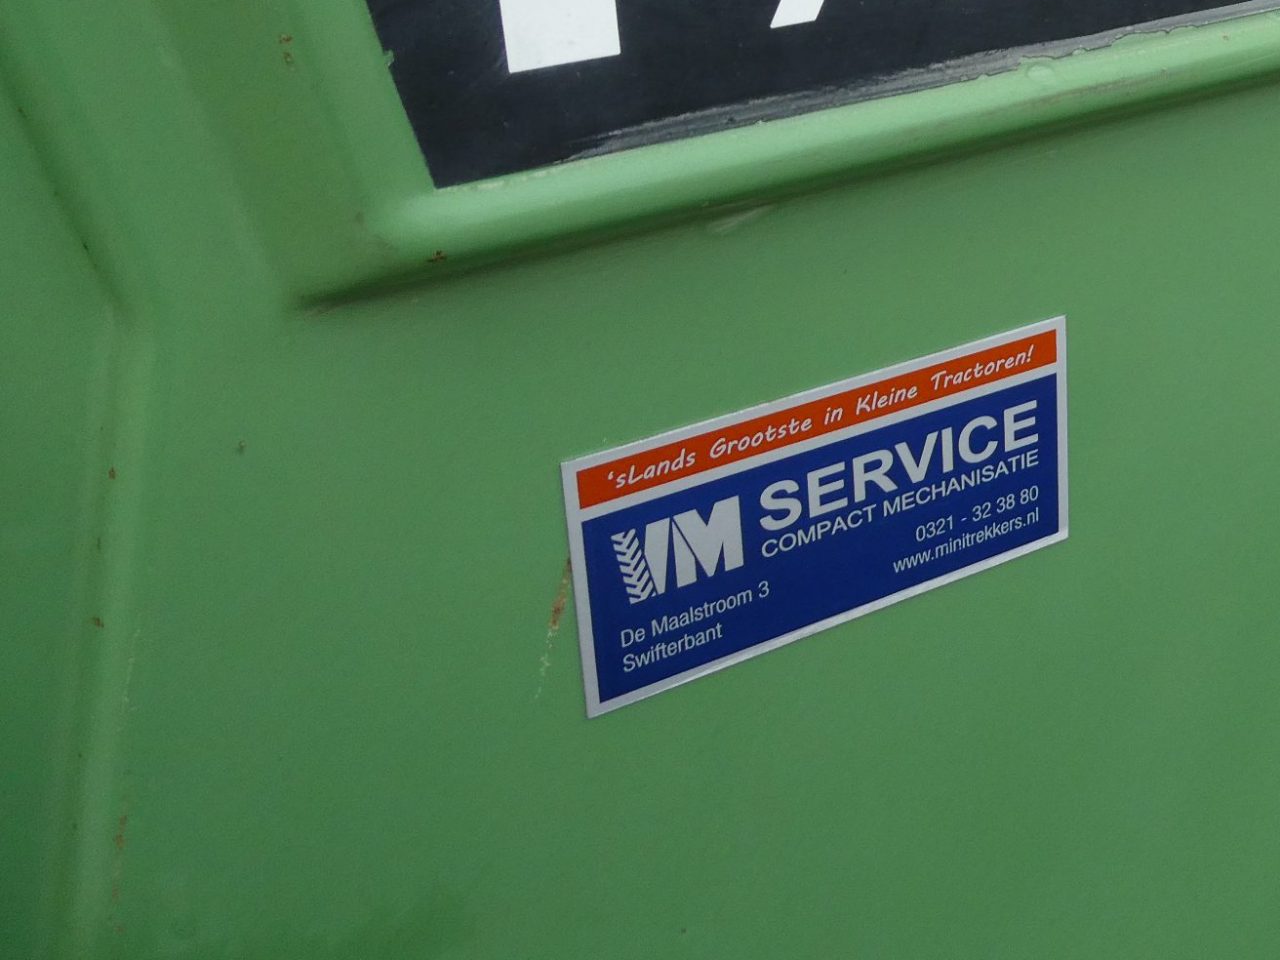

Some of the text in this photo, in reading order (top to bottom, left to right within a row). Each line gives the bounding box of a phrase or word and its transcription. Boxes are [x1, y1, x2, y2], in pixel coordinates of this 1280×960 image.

[709, 418, 812, 459] Grootste
[824, 407, 843, 425] in
[856, 385, 918, 415] Kleine
[930, 344, 1034, 390] Tractoren!
[759, 400, 1039, 531] SERVICE
[761, 449, 1039, 558] COMPACT MECHANISATIE
[916, 515, 953, 542] 0321
[971, 502, 991, 523] 32
[996, 494, 1015, 514] 38
[1020, 485, 1039, 507] 80
[893, 507, 1039, 573] www.minitrekkers.nl
[620, 580, 770, 648] De Maalstroom 3
[622, 622, 723, 672] Swifterbant
